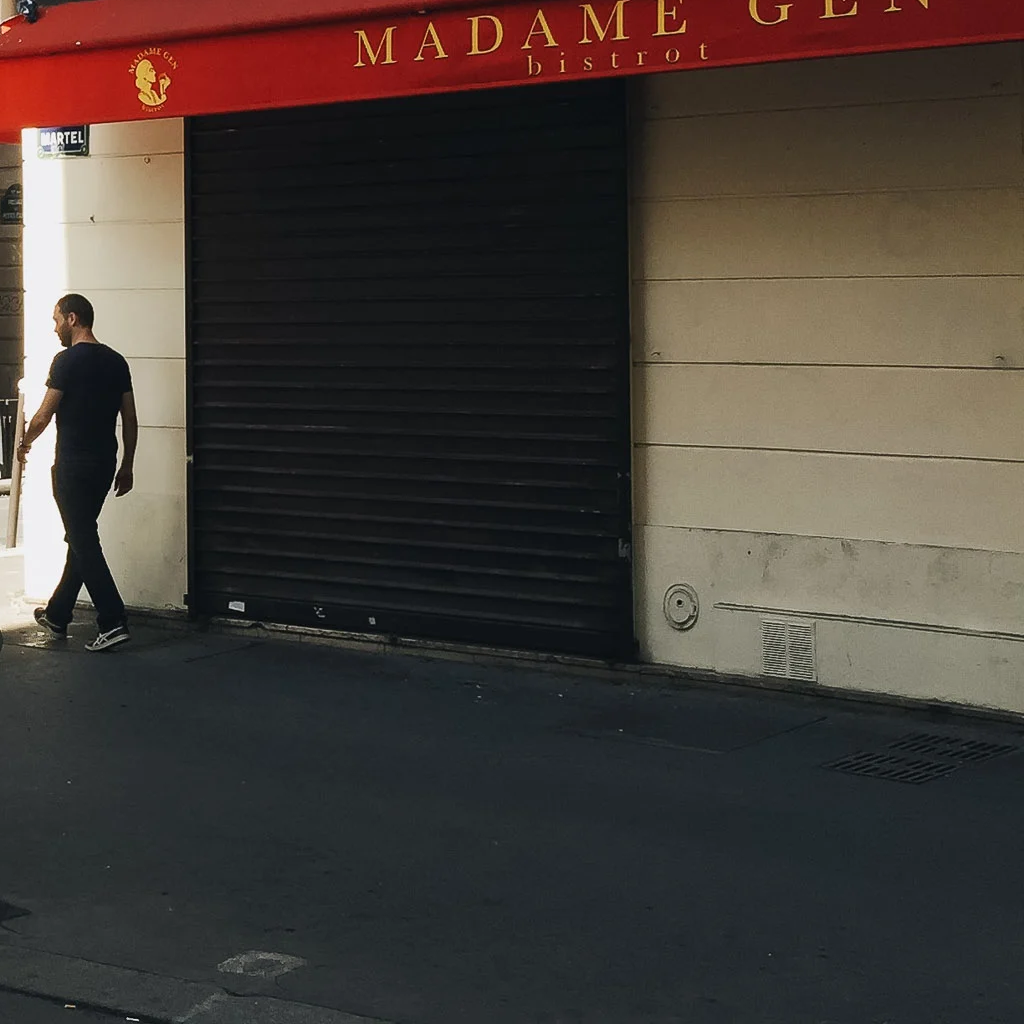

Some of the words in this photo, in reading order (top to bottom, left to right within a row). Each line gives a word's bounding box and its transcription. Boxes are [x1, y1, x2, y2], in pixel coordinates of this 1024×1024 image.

[128, 47, 162, 74] MADAME
[163, 51, 178, 70] GEN
[527, 42, 708, 76] bistrot
[40, 130, 84, 146] MARTEL
